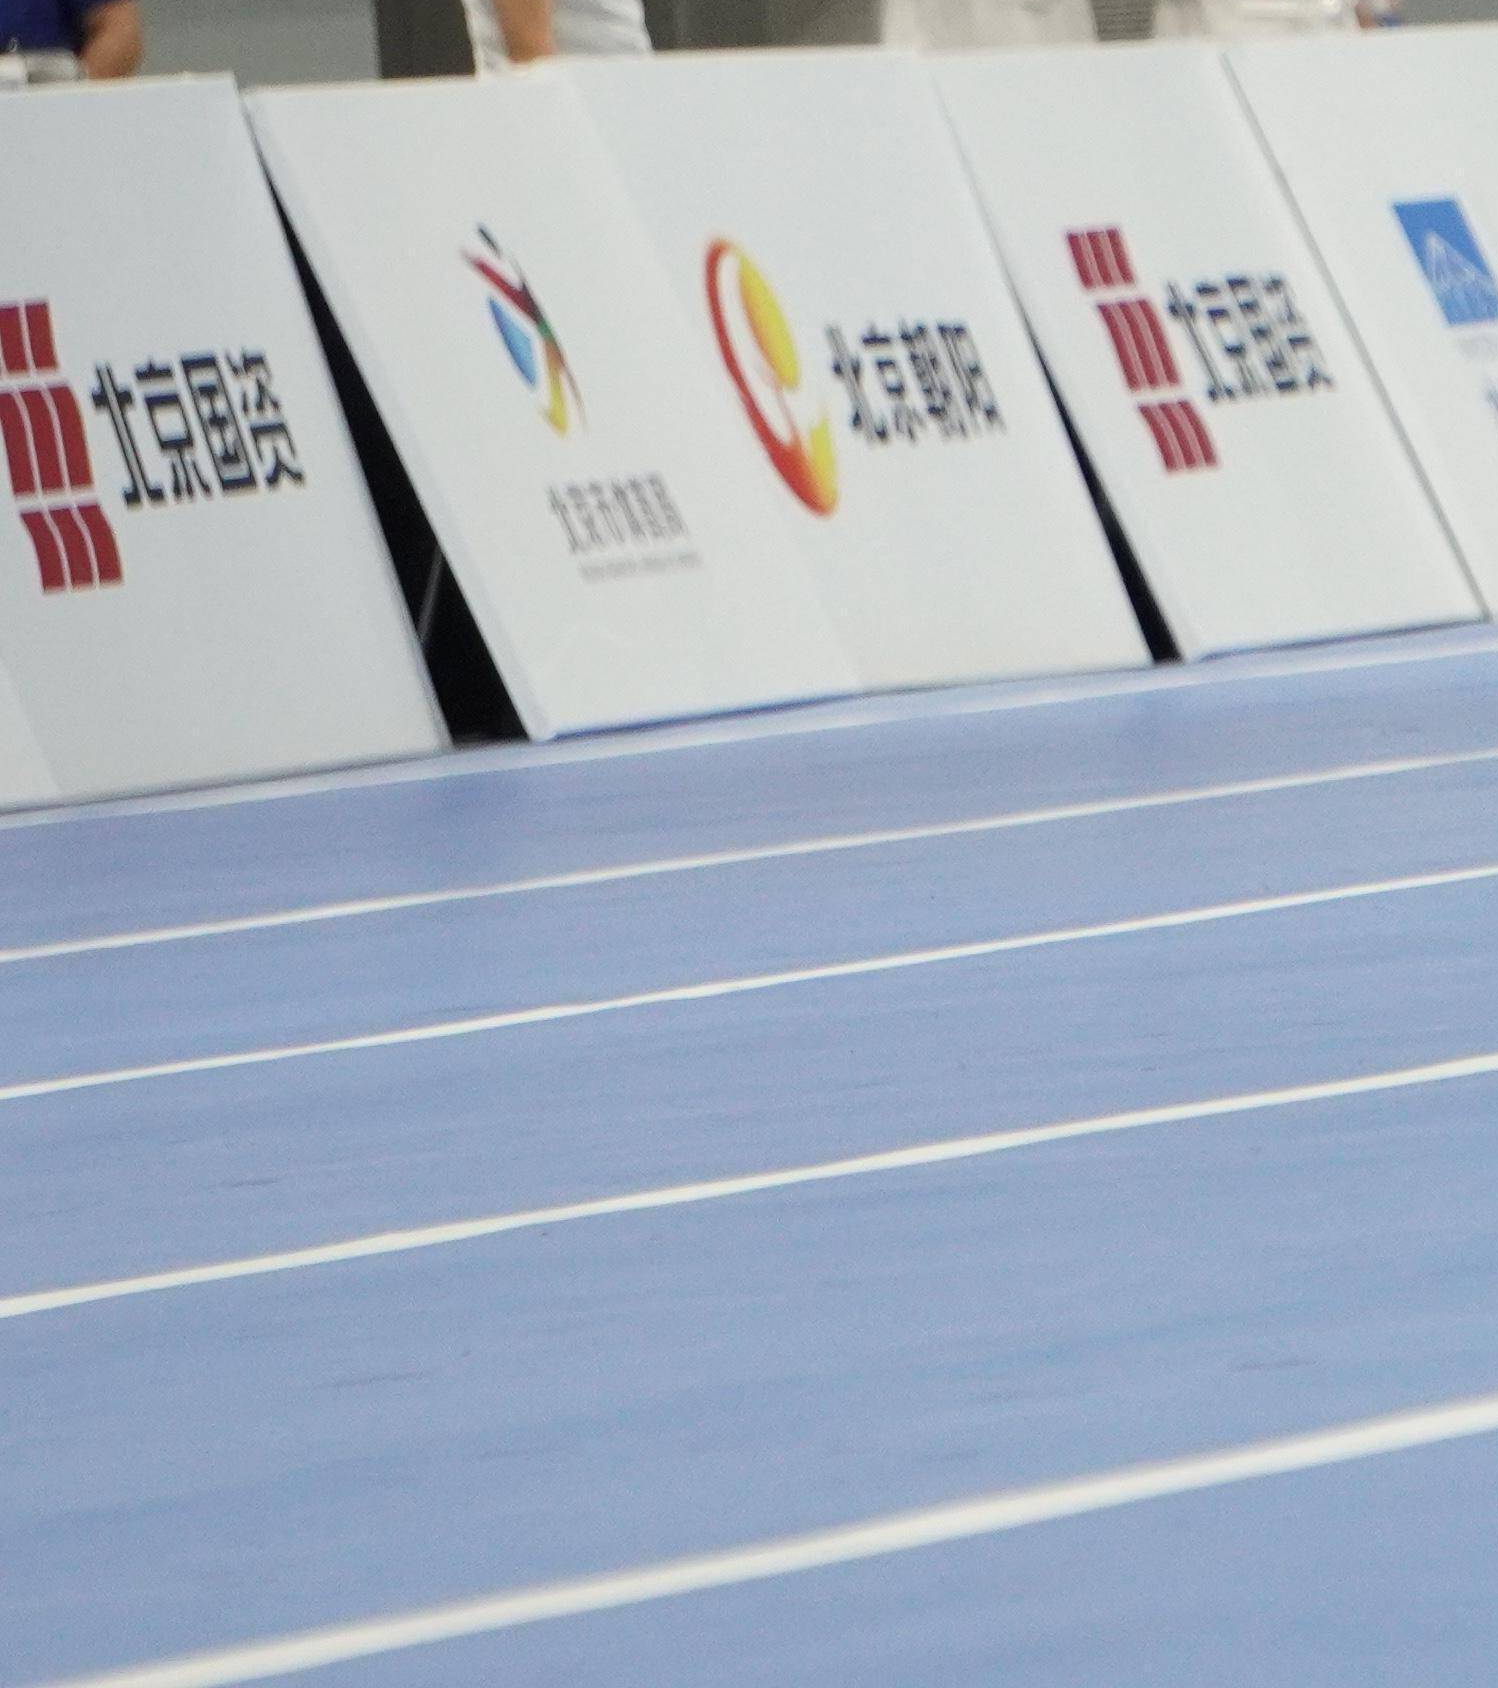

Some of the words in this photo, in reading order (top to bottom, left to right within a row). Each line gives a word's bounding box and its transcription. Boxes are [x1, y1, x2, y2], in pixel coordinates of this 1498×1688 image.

[824, 320, 1006, 446] 北京朝阳
[1166, 274, 1335, 404] 北京国资
[90, 348, 306, 510] 北京国资
